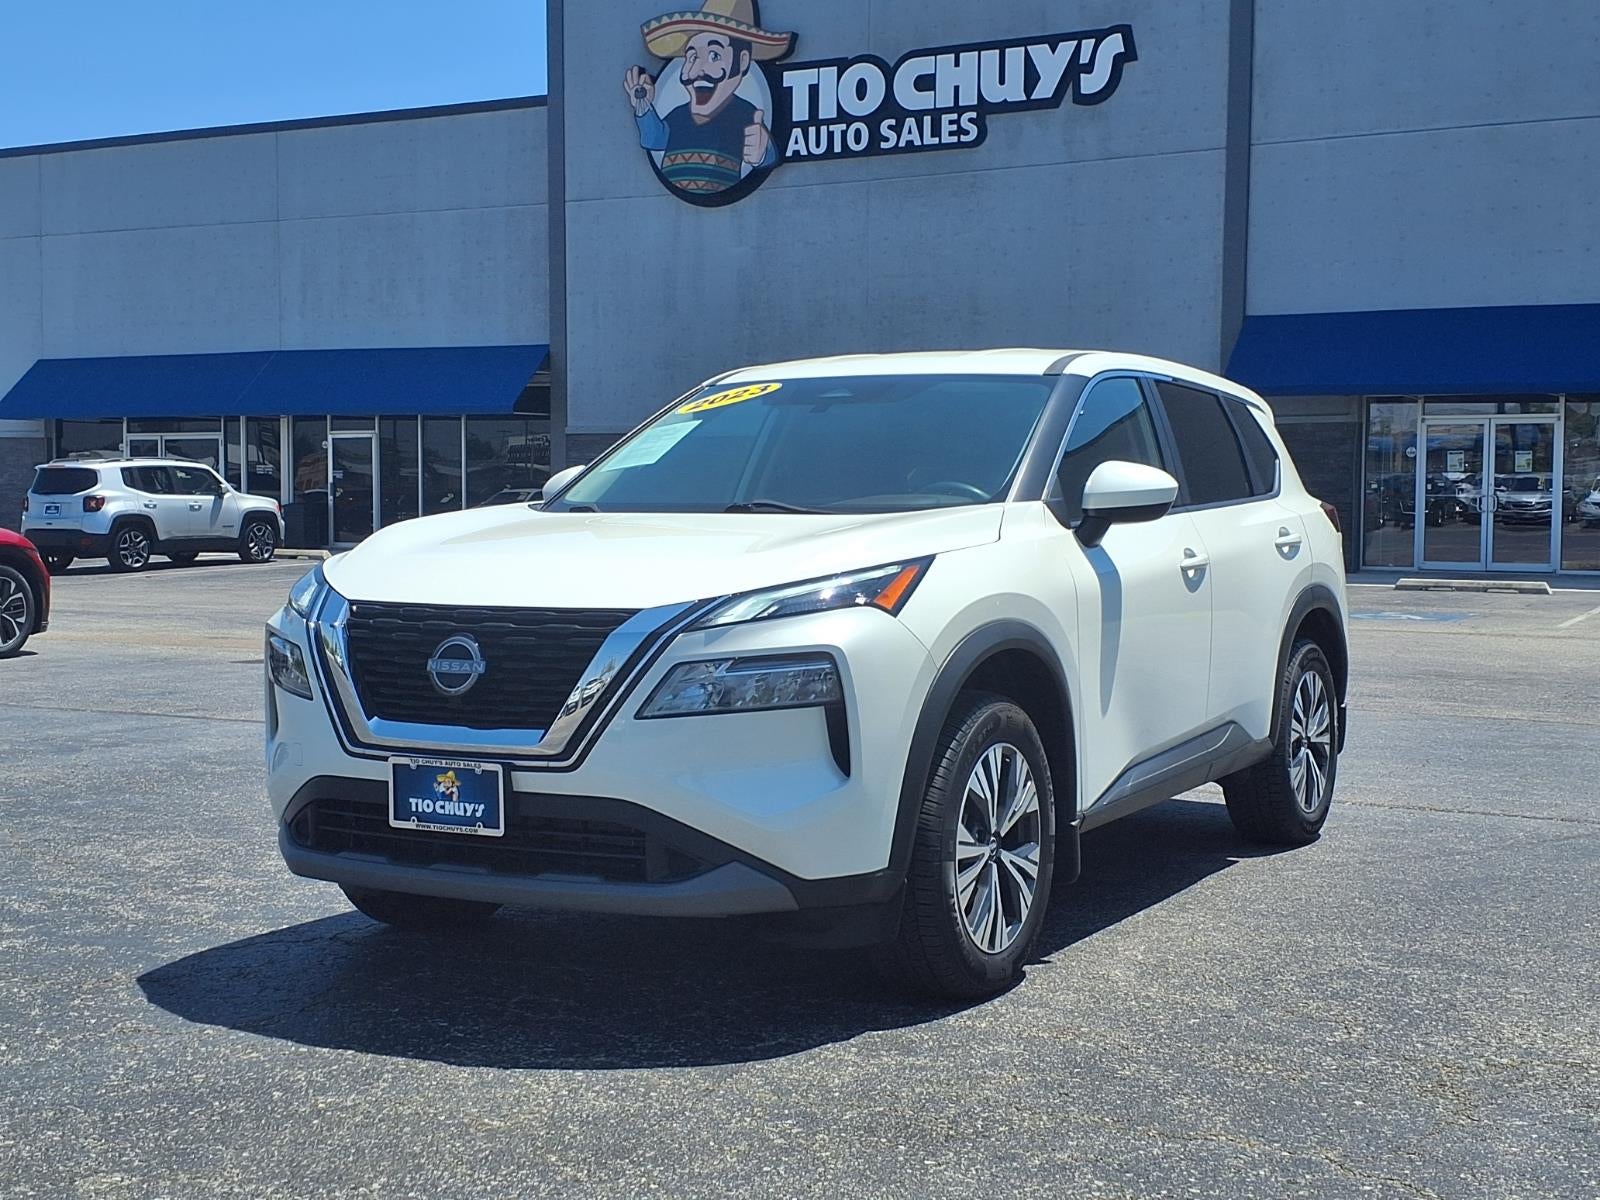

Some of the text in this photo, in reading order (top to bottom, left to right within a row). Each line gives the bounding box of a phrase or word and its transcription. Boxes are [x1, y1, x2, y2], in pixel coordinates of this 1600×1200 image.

[783, 32, 1125, 122] TIO CHUY'S
[785, 111, 978, 157] AUTO SALES
[686, 385, 772, 411] 2023
[429, 661, 483, 672] NISSAN
[409, 797, 485, 817] TIO CHUY'S
[415, 824, 479, 833] WWW.TIOCHUYS.COM
